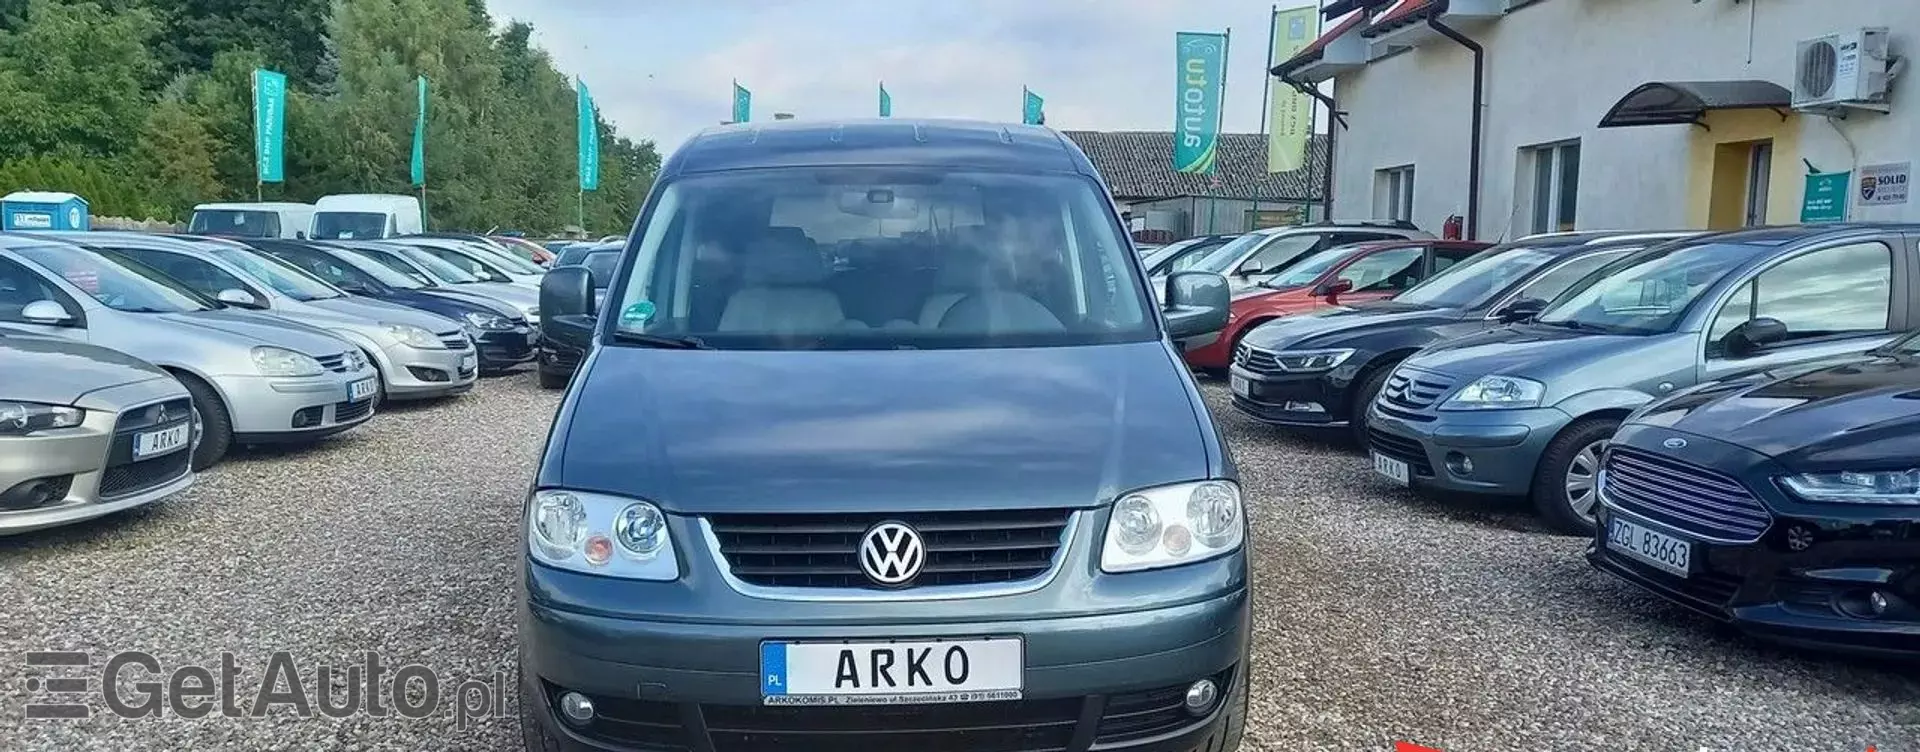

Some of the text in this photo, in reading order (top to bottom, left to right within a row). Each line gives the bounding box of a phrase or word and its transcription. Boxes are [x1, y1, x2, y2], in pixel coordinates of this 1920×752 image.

[1183, 58, 1207, 148] autotu
[263, 137, 271, 155] BNP
[1878, 173, 1907, 185] SOLID
[152, 428, 180, 451] ARKO
[1377, 455, 1401, 479] ARKO
[1614, 520, 1688, 569] ZGL 83663
[835, 645, 970, 689] ARKO
[767, 676, 783, 686] PL
